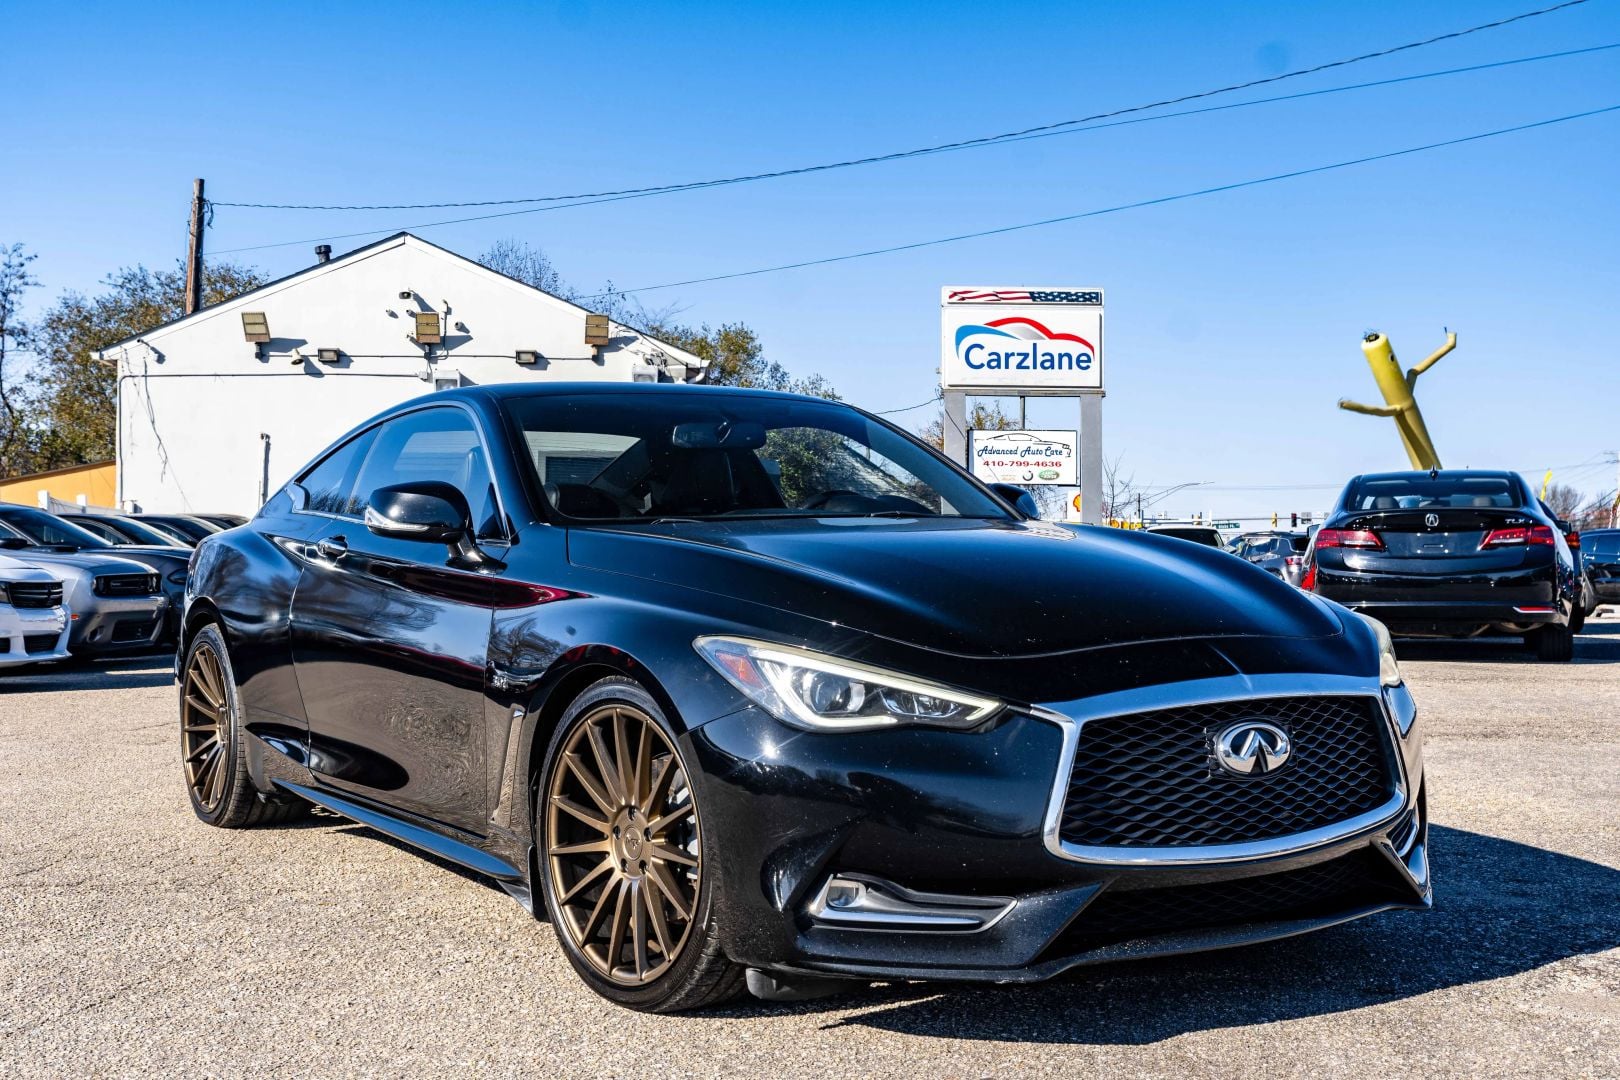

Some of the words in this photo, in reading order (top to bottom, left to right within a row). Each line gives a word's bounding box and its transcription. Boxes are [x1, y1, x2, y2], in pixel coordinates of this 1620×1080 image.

[965, 343, 1092, 371] Carzlane
[978, 445, 1019, 457] Advanced
[1020, 446, 1043, 457] Auto
[1045, 446, 1063, 457] Care
